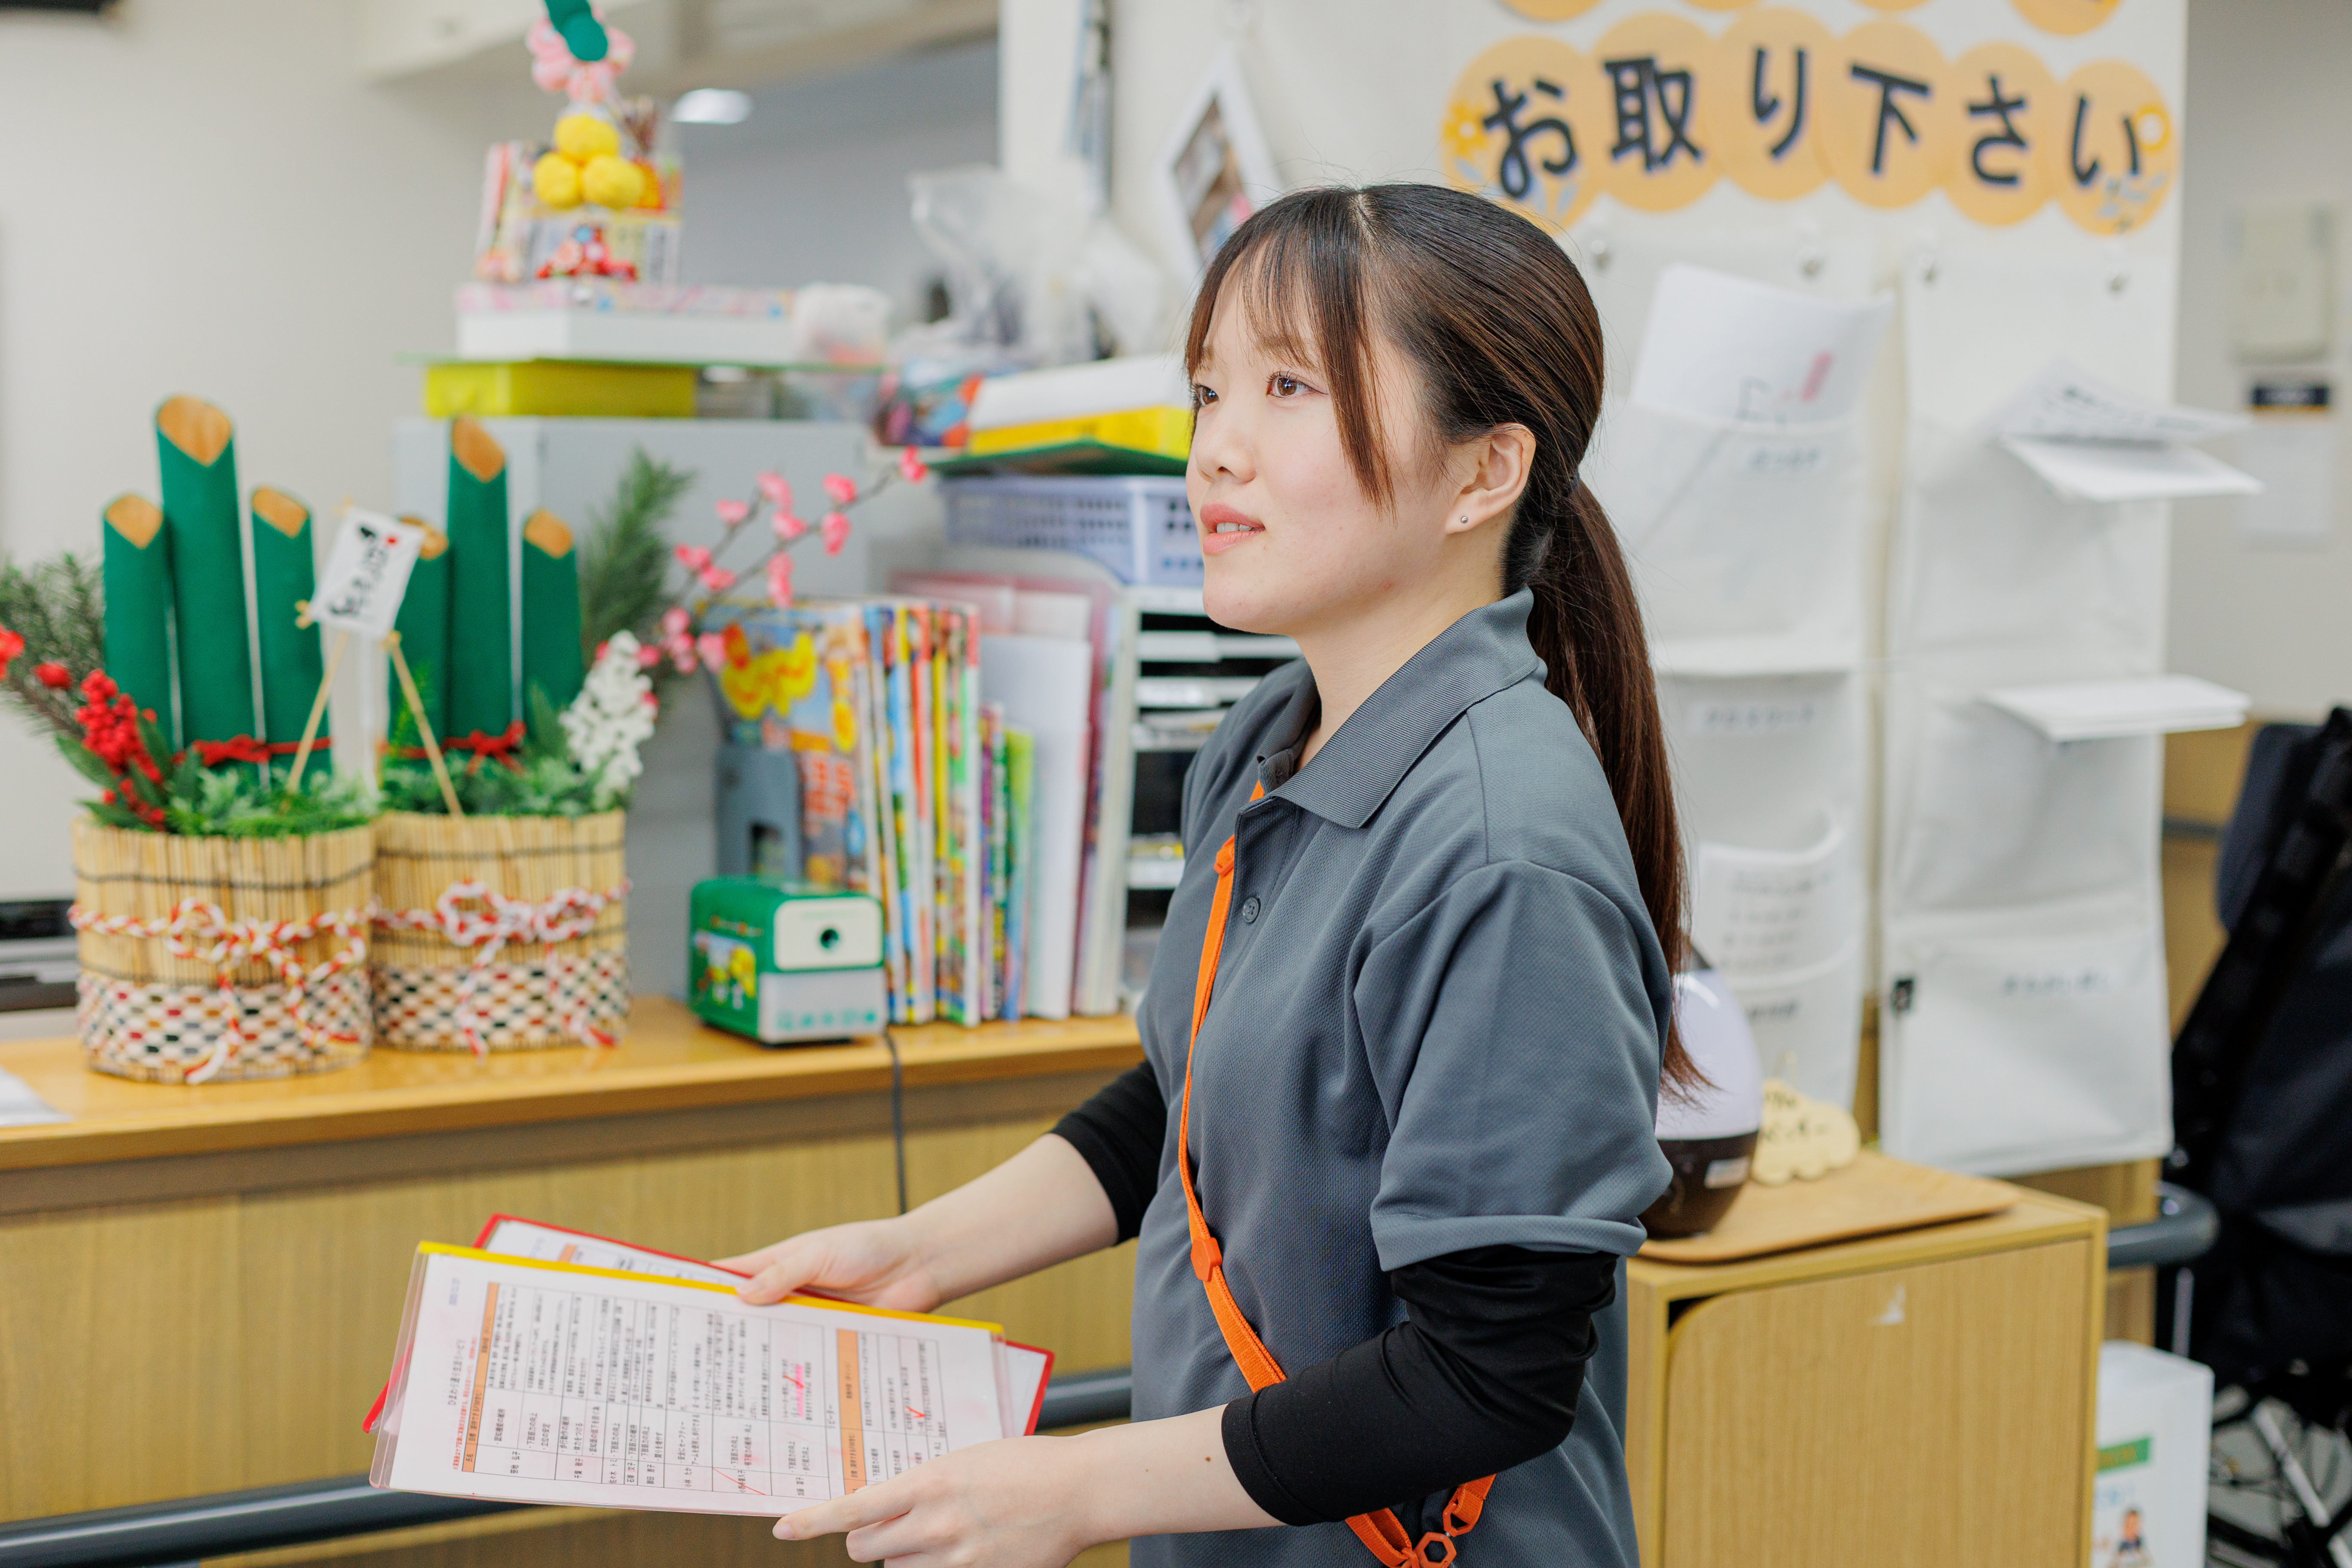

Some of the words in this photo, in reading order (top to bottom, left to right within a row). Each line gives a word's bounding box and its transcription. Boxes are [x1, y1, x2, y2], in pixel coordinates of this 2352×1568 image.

[1481, 45, 2141, 200] お取り下さい
[466, 1453, 473, 1462] 氏名
[608, 1470, 617, 1483] 佐々木
